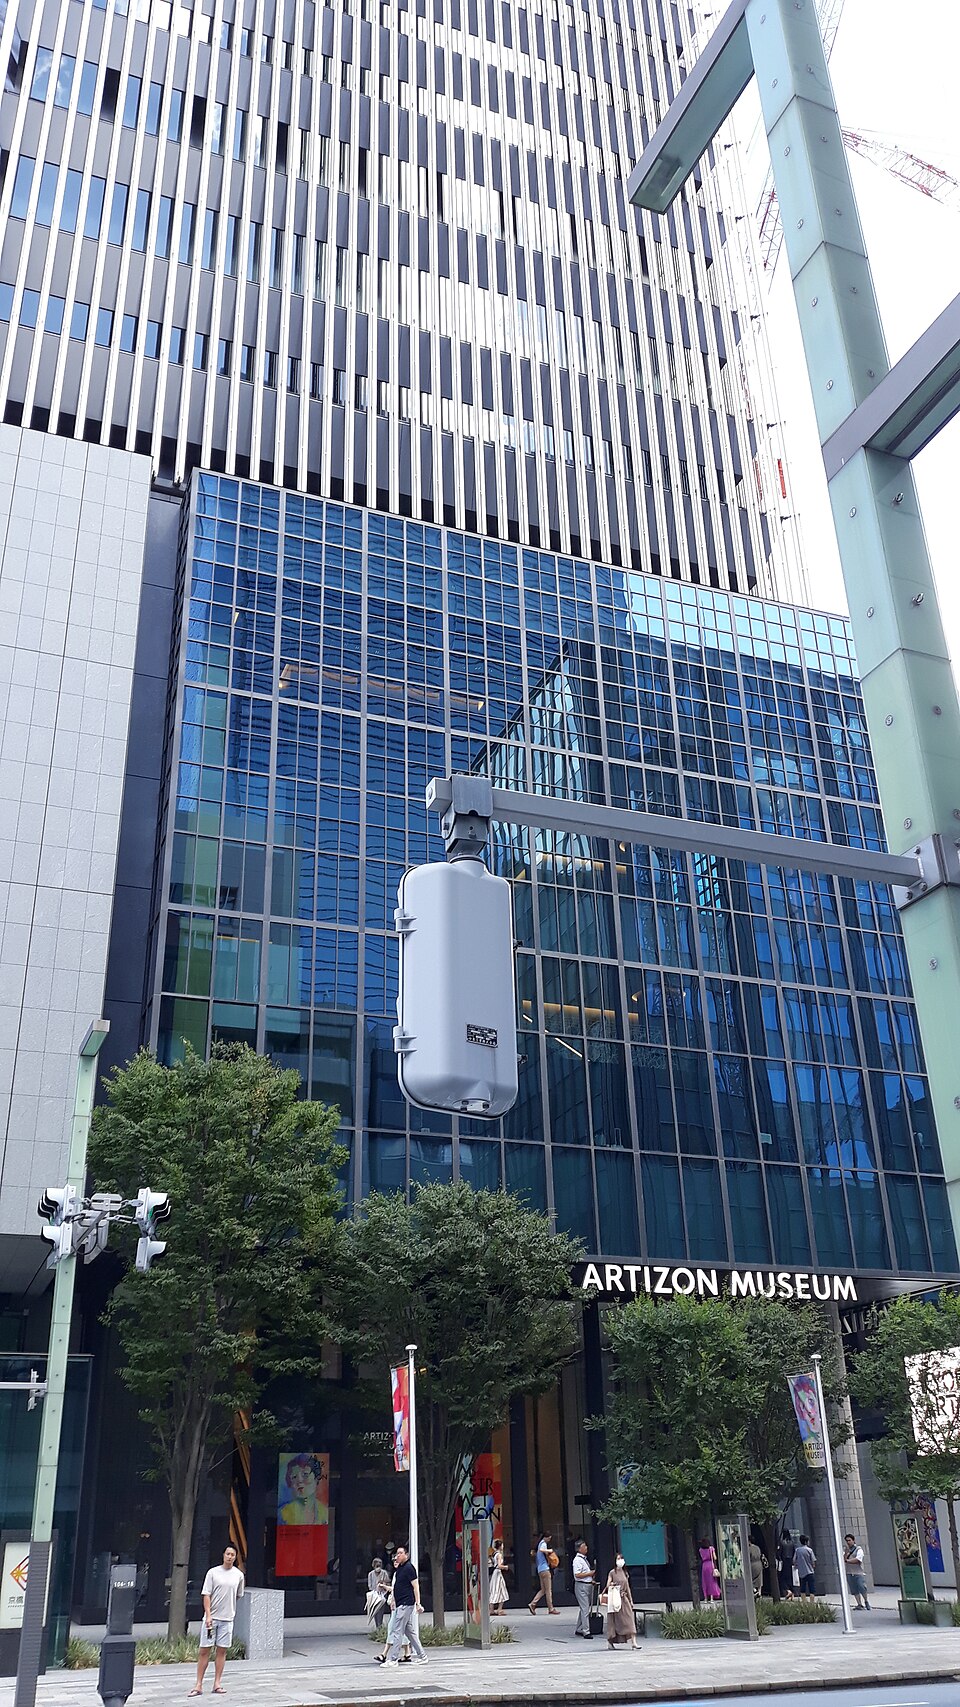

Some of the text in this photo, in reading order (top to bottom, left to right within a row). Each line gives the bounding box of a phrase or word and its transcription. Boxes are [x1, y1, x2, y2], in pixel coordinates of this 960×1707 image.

[582, 1263, 858, 1301] ARTIZON MUSEUM
[804, 1442, 824, 1450] ARTIZO
